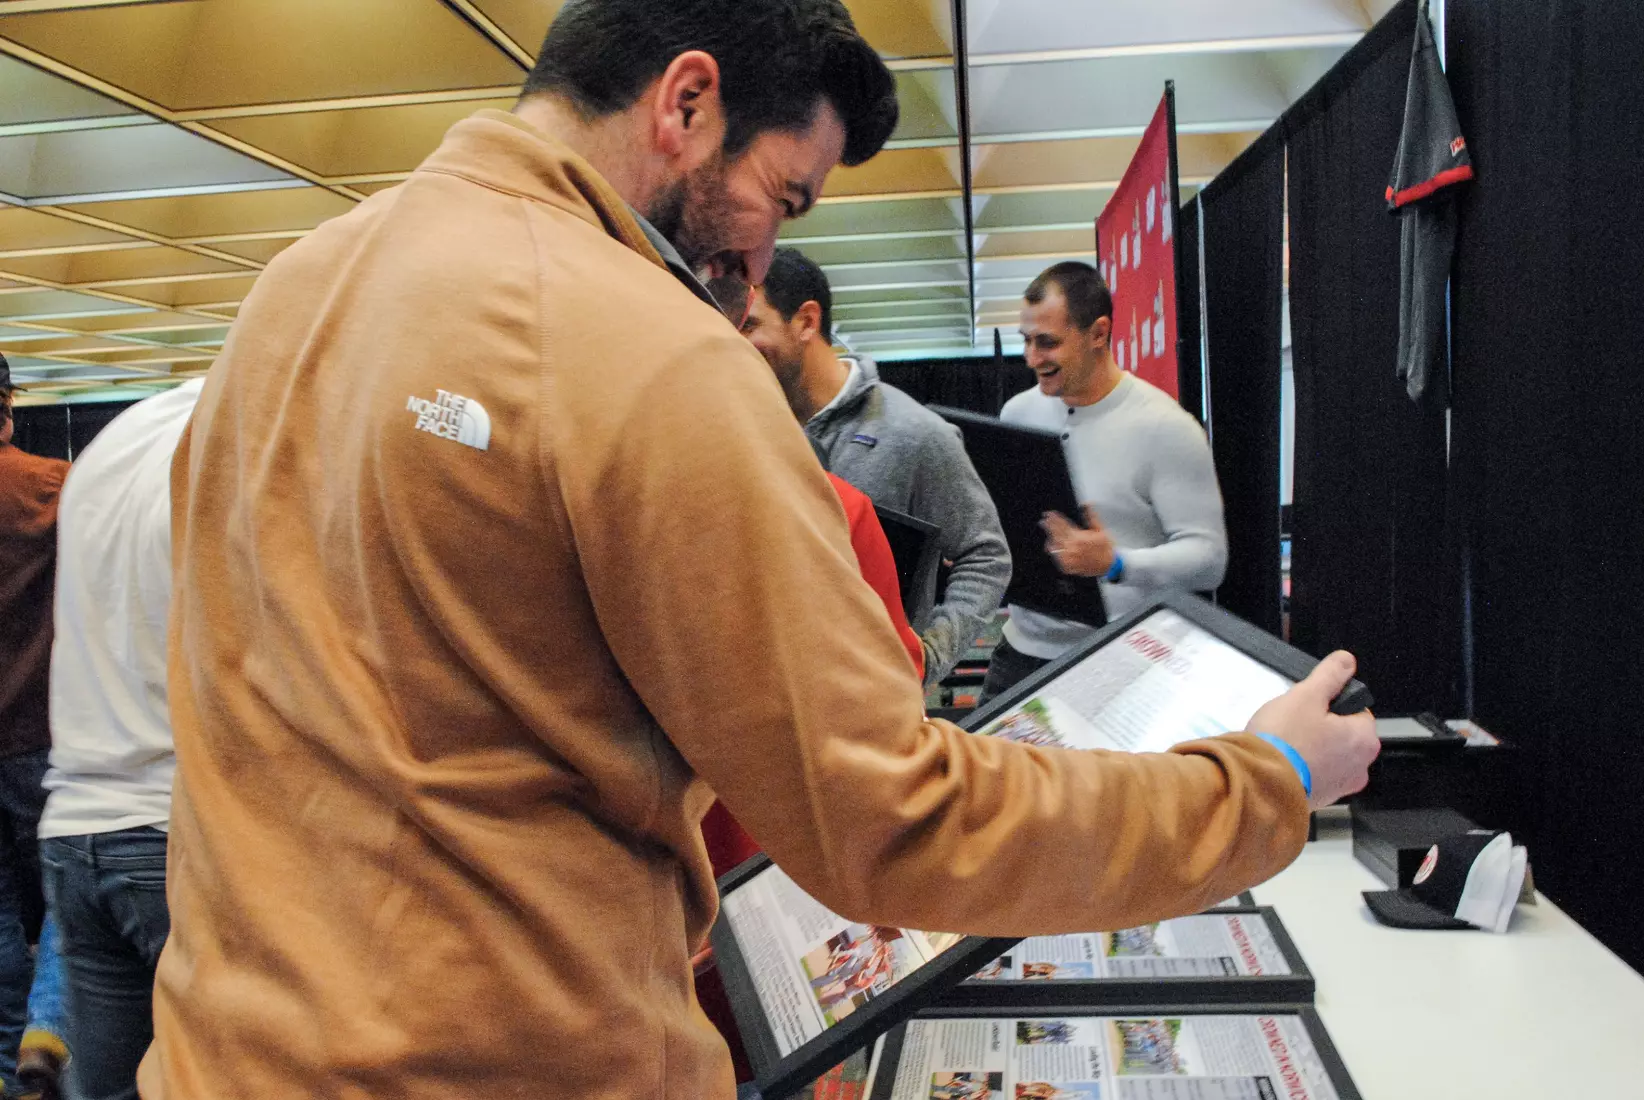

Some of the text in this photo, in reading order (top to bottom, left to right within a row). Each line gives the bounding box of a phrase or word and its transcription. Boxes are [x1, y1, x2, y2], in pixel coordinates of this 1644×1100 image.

[406, 395, 463, 427] NORTH
[436, 389, 466, 411] THE
[415, 415, 460, 440] FACE
